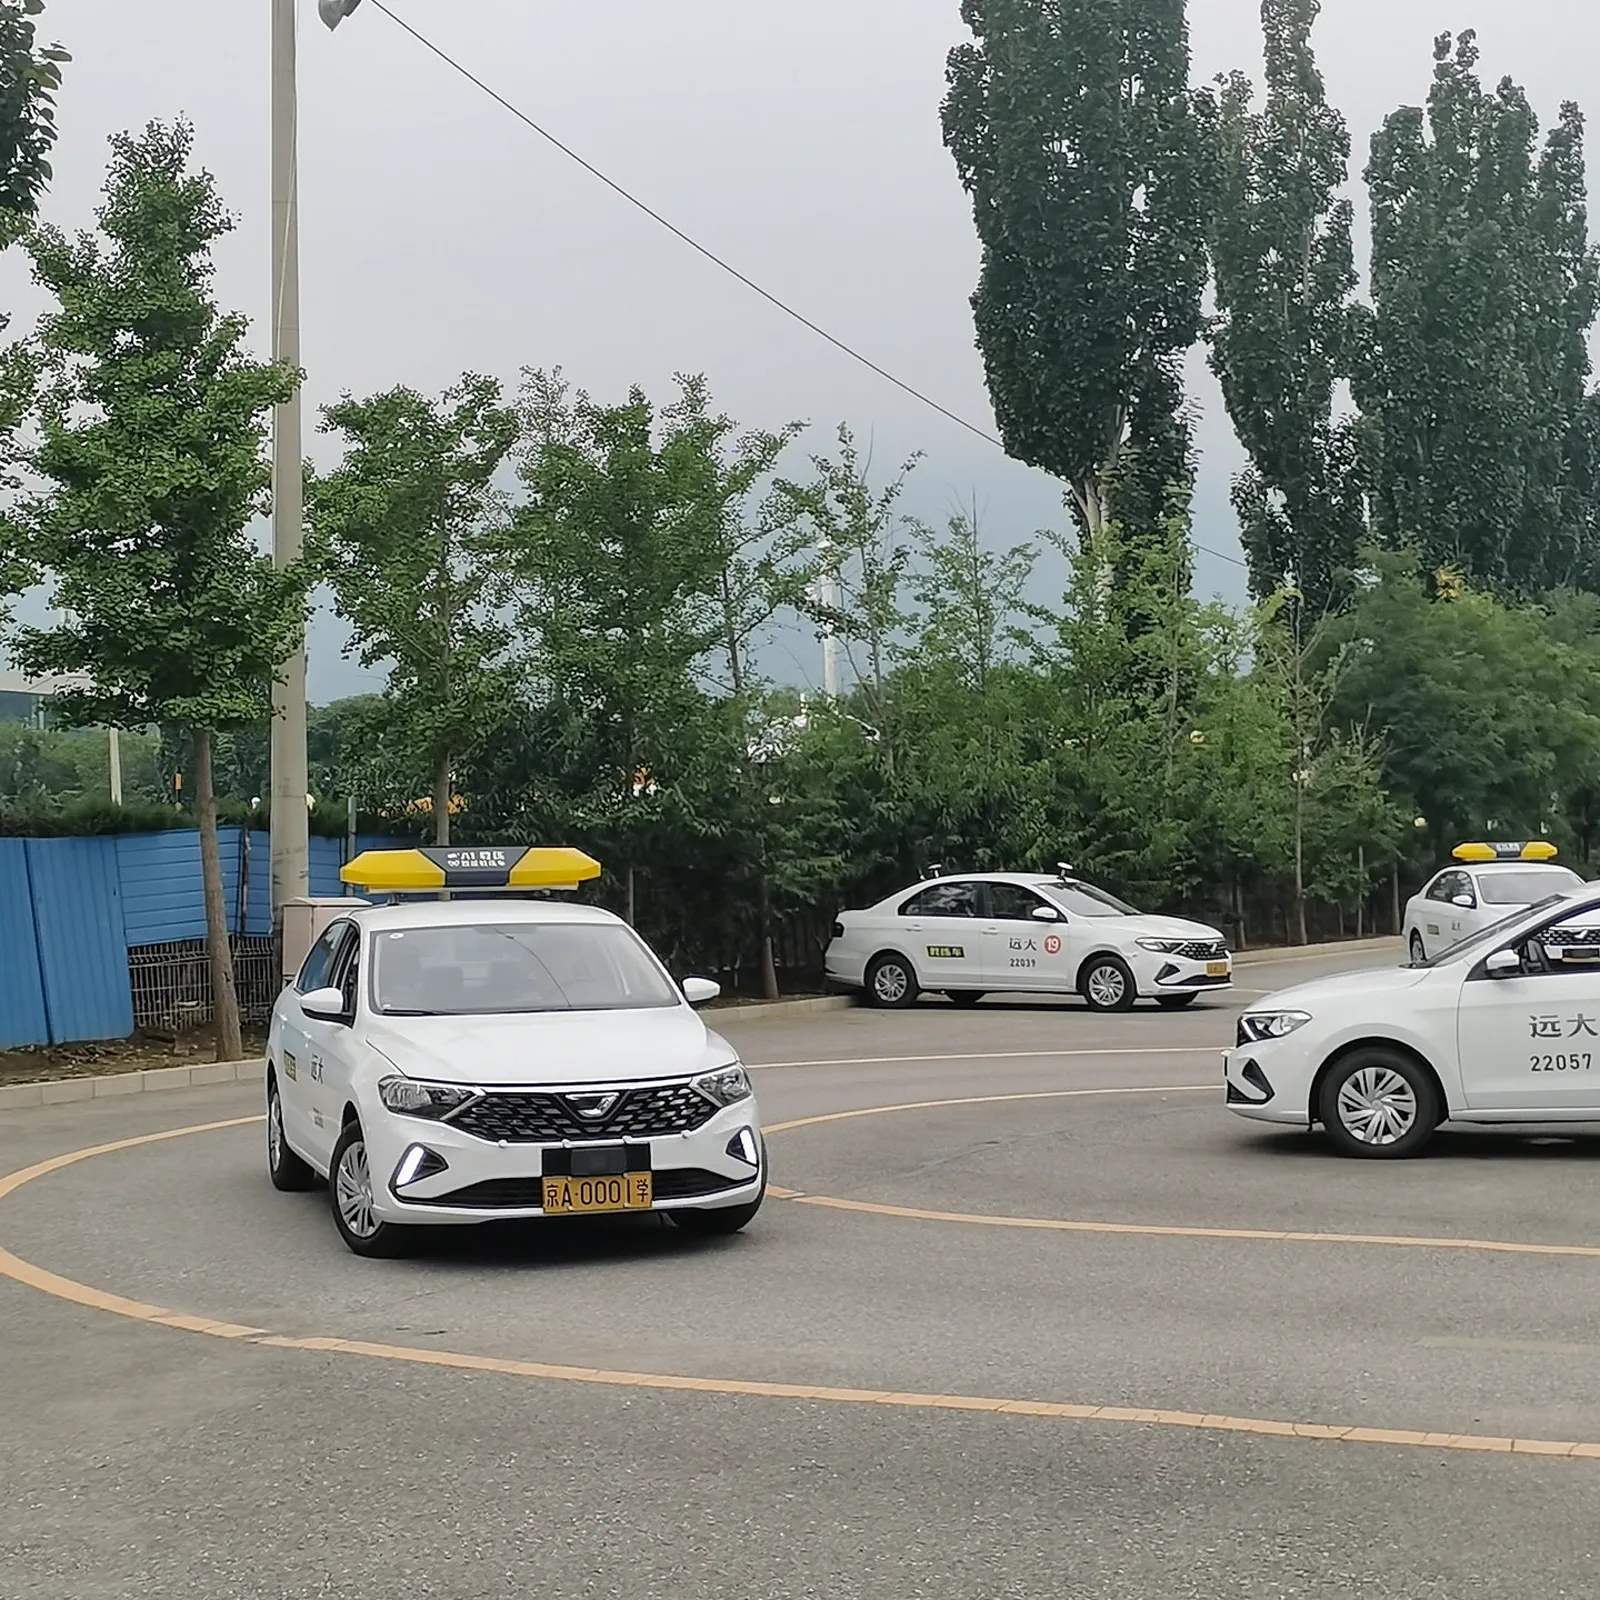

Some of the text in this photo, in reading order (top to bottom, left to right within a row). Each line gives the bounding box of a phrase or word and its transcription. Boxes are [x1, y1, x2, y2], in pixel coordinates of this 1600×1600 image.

[1009, 938, 1059, 951] 远大 19
[1009, 958, 1036, 968] 22039
[1528, 1013, 1599, 1038] 远大
[1529, 1053, 1592, 1071] 22057
